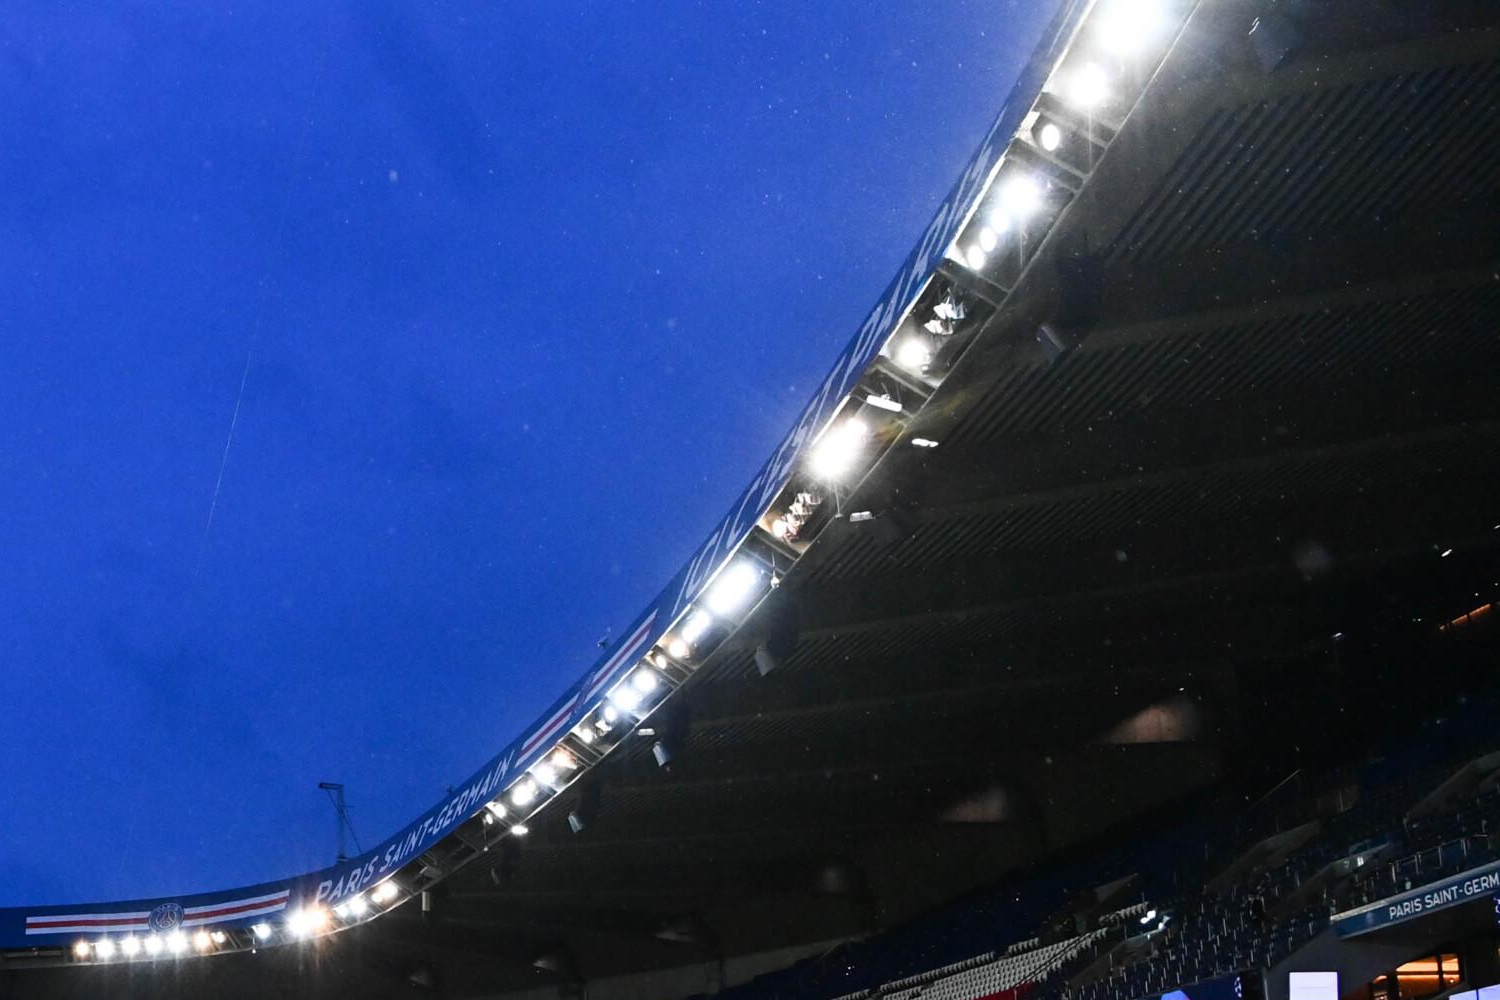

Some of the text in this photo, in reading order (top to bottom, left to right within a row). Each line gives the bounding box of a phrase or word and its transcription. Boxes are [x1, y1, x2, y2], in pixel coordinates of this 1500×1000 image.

[314, 749, 515, 902] PARIS SAINT-GERMAIN
[1389, 872, 1500, 920] PARIS SAINT-GERM
